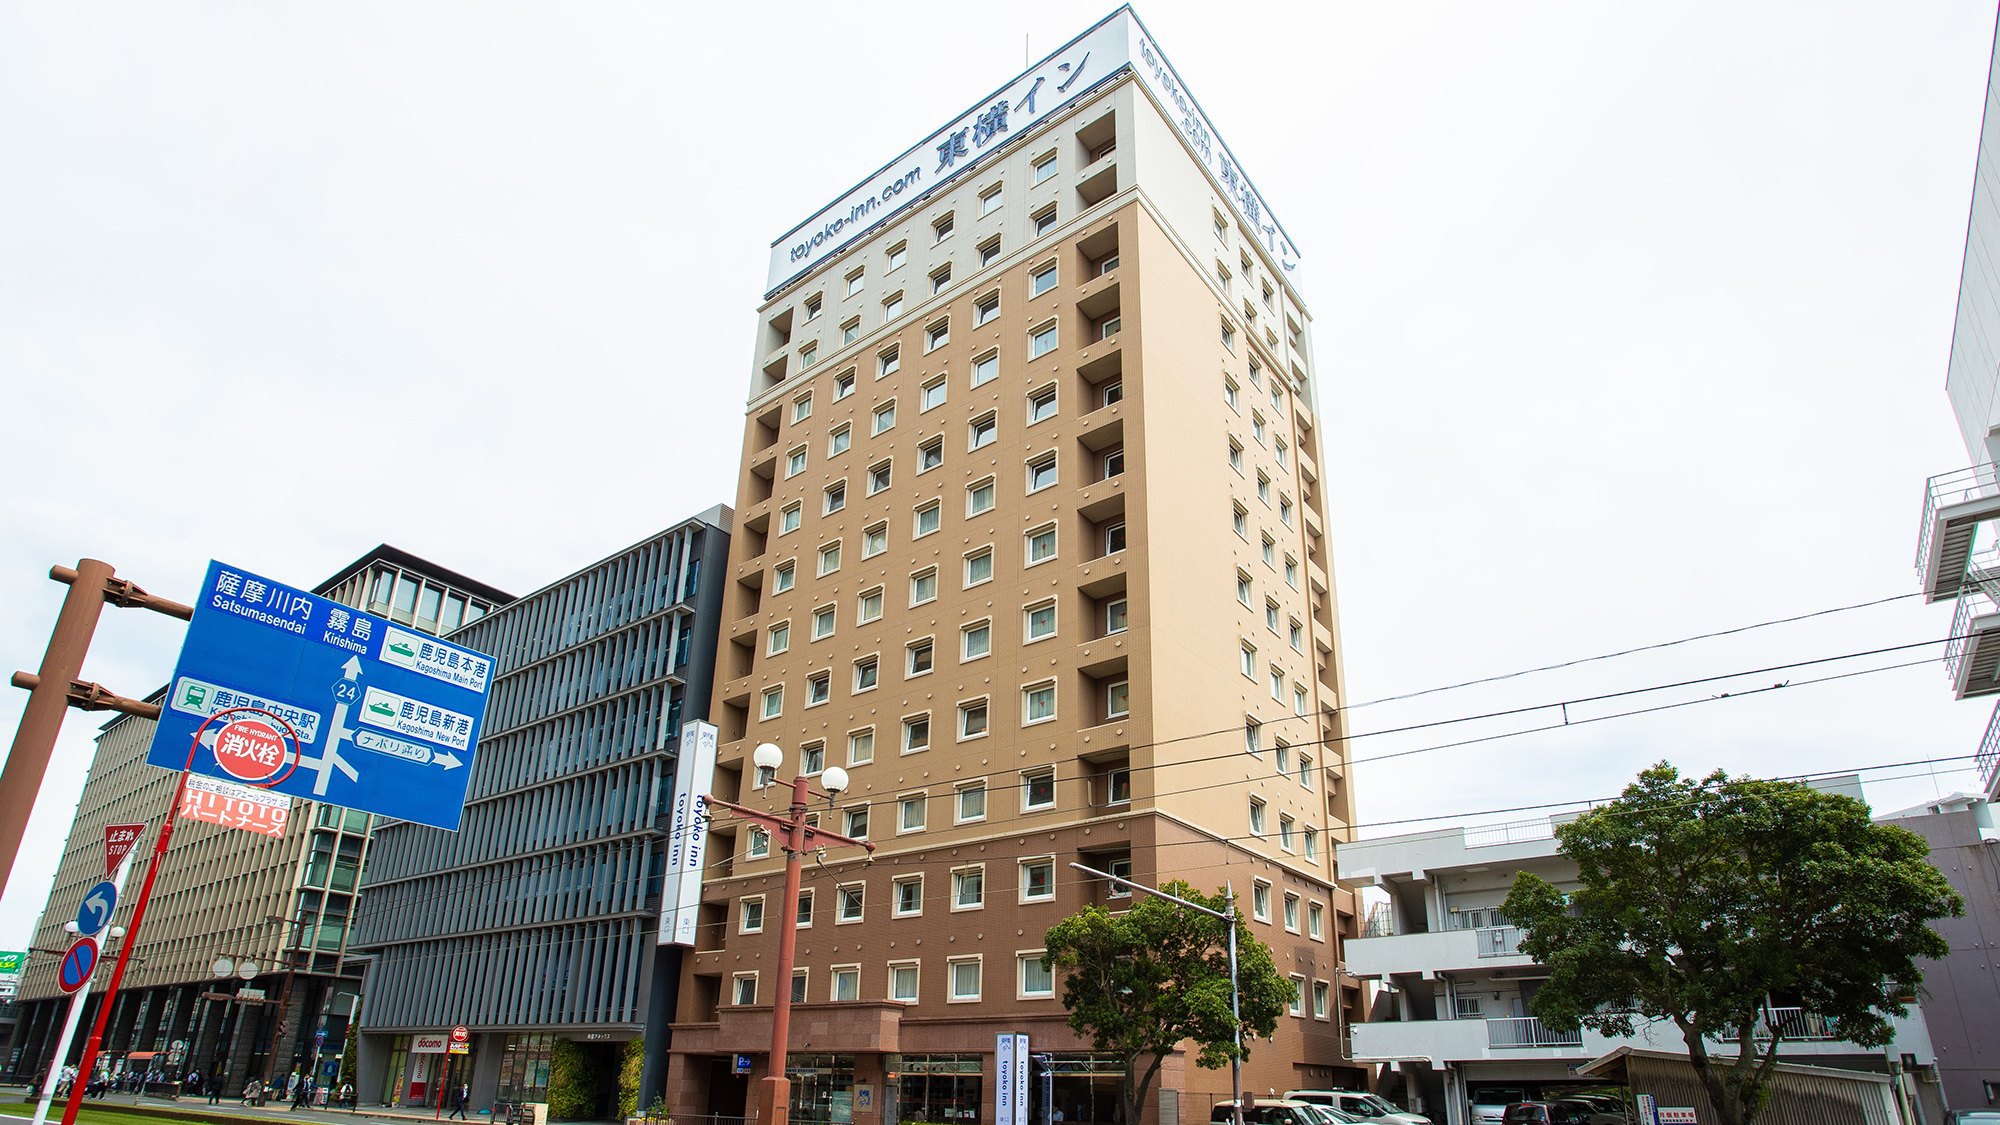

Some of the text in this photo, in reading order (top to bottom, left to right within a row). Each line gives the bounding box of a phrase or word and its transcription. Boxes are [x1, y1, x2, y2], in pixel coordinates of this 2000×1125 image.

[1139, 38, 1211, 150] toyoko-inn
[790, 51, 1091, 263] toyoko-inn.com 東横イン
[1217, 152, 1296, 272] 東横イン
[215, 570, 313, 621] 薩摩川内
[212, 594, 306, 635] Satsumasendai
[326, 607, 372, 642] 霧島
[322, 630, 367, 655] Kirishima
[415, 660, 484, 690] Kagoshima Main Port
[418, 642, 487, 679] 鹿児島本港
[336, 683, 356, 700] 24
[213, 690, 316, 731] 鹿児島中央駅
[400, 701, 470, 736] 鹿児島新港
[220, 731, 280, 767] 消火栓
[234, 725, 279, 741] FIRE HYDRANT
[294, 728, 312, 741] Sta.
[397, 720, 466, 747] Kagoshima New Port
[181, 803, 285, 837] パートナーズ
[185, 789, 287, 823] HITOTO
[108, 829, 134, 842] 止まれ
[671, 792, 687, 866] toyoko inn
[689, 794, 704, 867] toyoko inn
[108, 844, 128, 855] STOP
[417, 1038, 442, 1048] docomo
[738, 1057, 745, 1066] P
